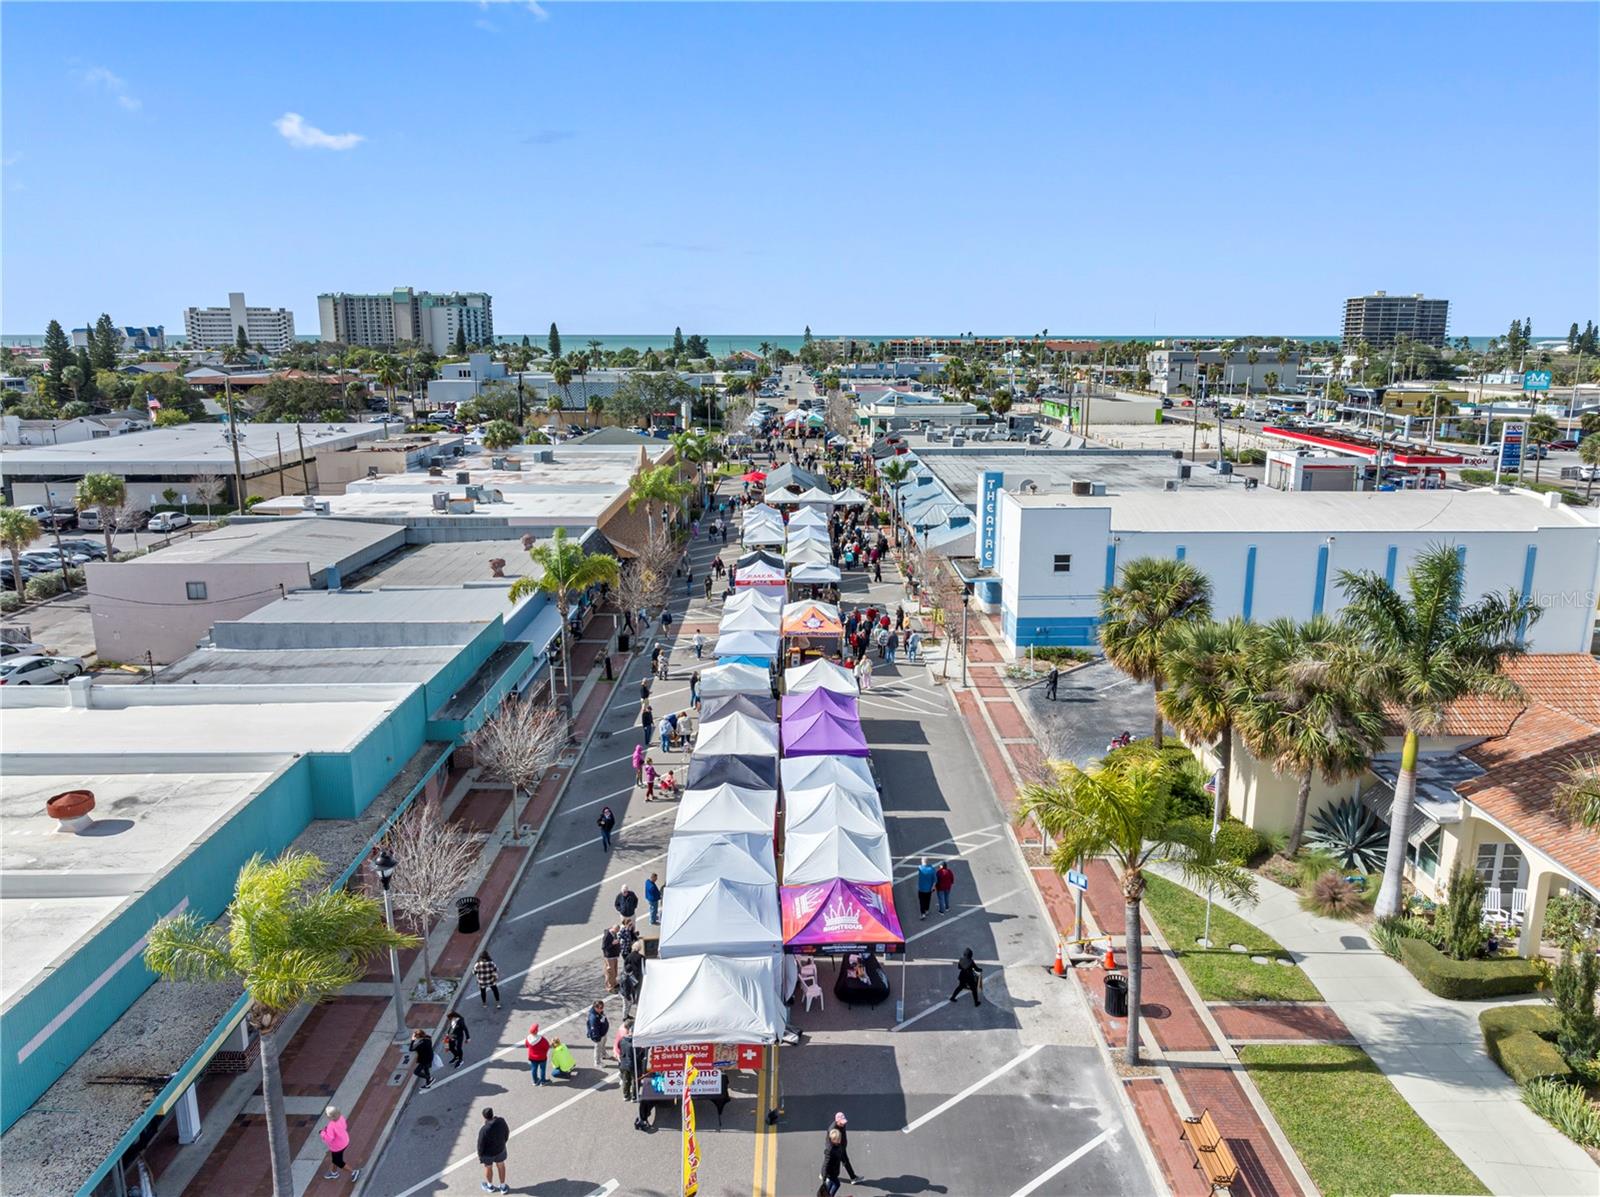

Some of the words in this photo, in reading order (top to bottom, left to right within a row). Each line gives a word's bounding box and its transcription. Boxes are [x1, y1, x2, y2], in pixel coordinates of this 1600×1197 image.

[1507, 424, 1524, 432] EXXO
[1464, 458, 1488, 466] EXXON
[985, 479, 996, 561] THEATRE
[823, 924, 863, 932] RIGHTEOUS
[653, 1044, 709, 1053] Extreme
[667, 1070, 719, 1078] Exme
